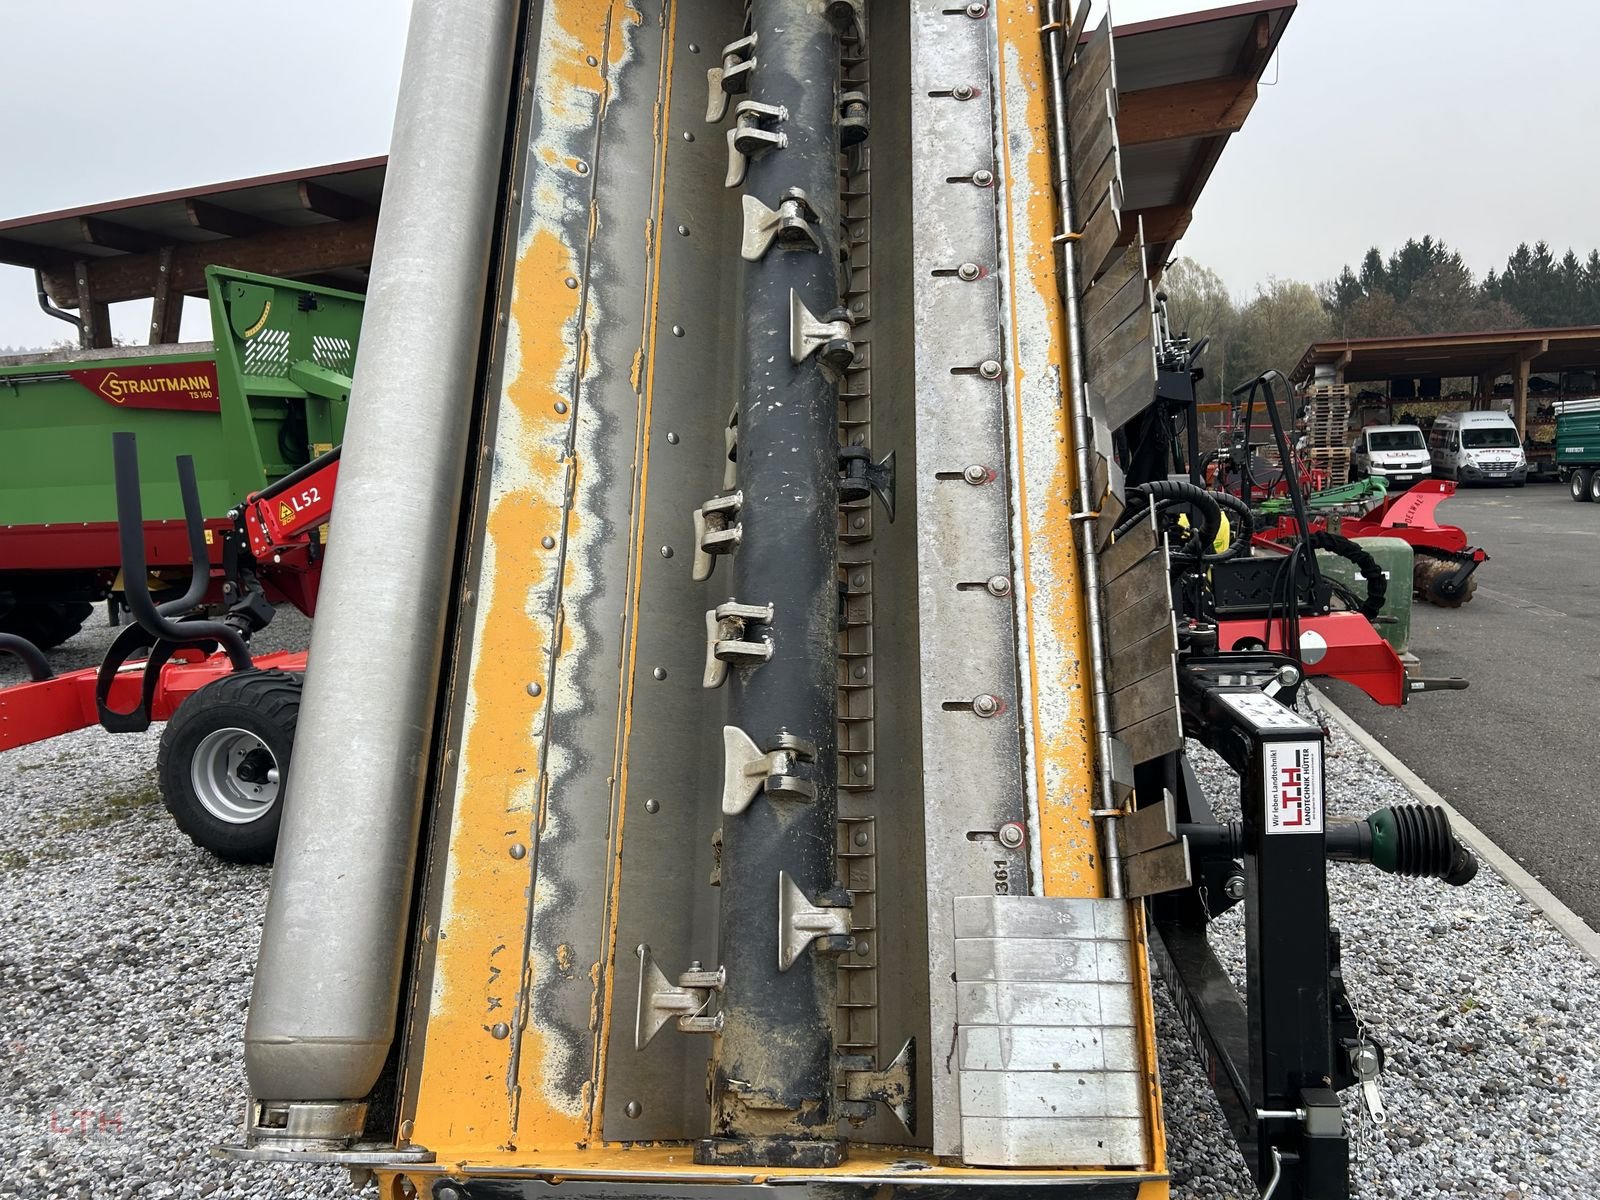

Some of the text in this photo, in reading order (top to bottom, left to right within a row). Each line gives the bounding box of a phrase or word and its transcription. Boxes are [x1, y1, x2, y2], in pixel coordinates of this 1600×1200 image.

[109, 375, 211, 396] STRAUTMANN
[189, 390, 213, 399] TS 160
[291, 487, 321, 512] L52
[1270, 749, 1278, 793] Landtechnik!
[1302, 748, 1311, 826] LANDTECHNIK HÜTTER
[1271, 792, 1279, 813] leben
